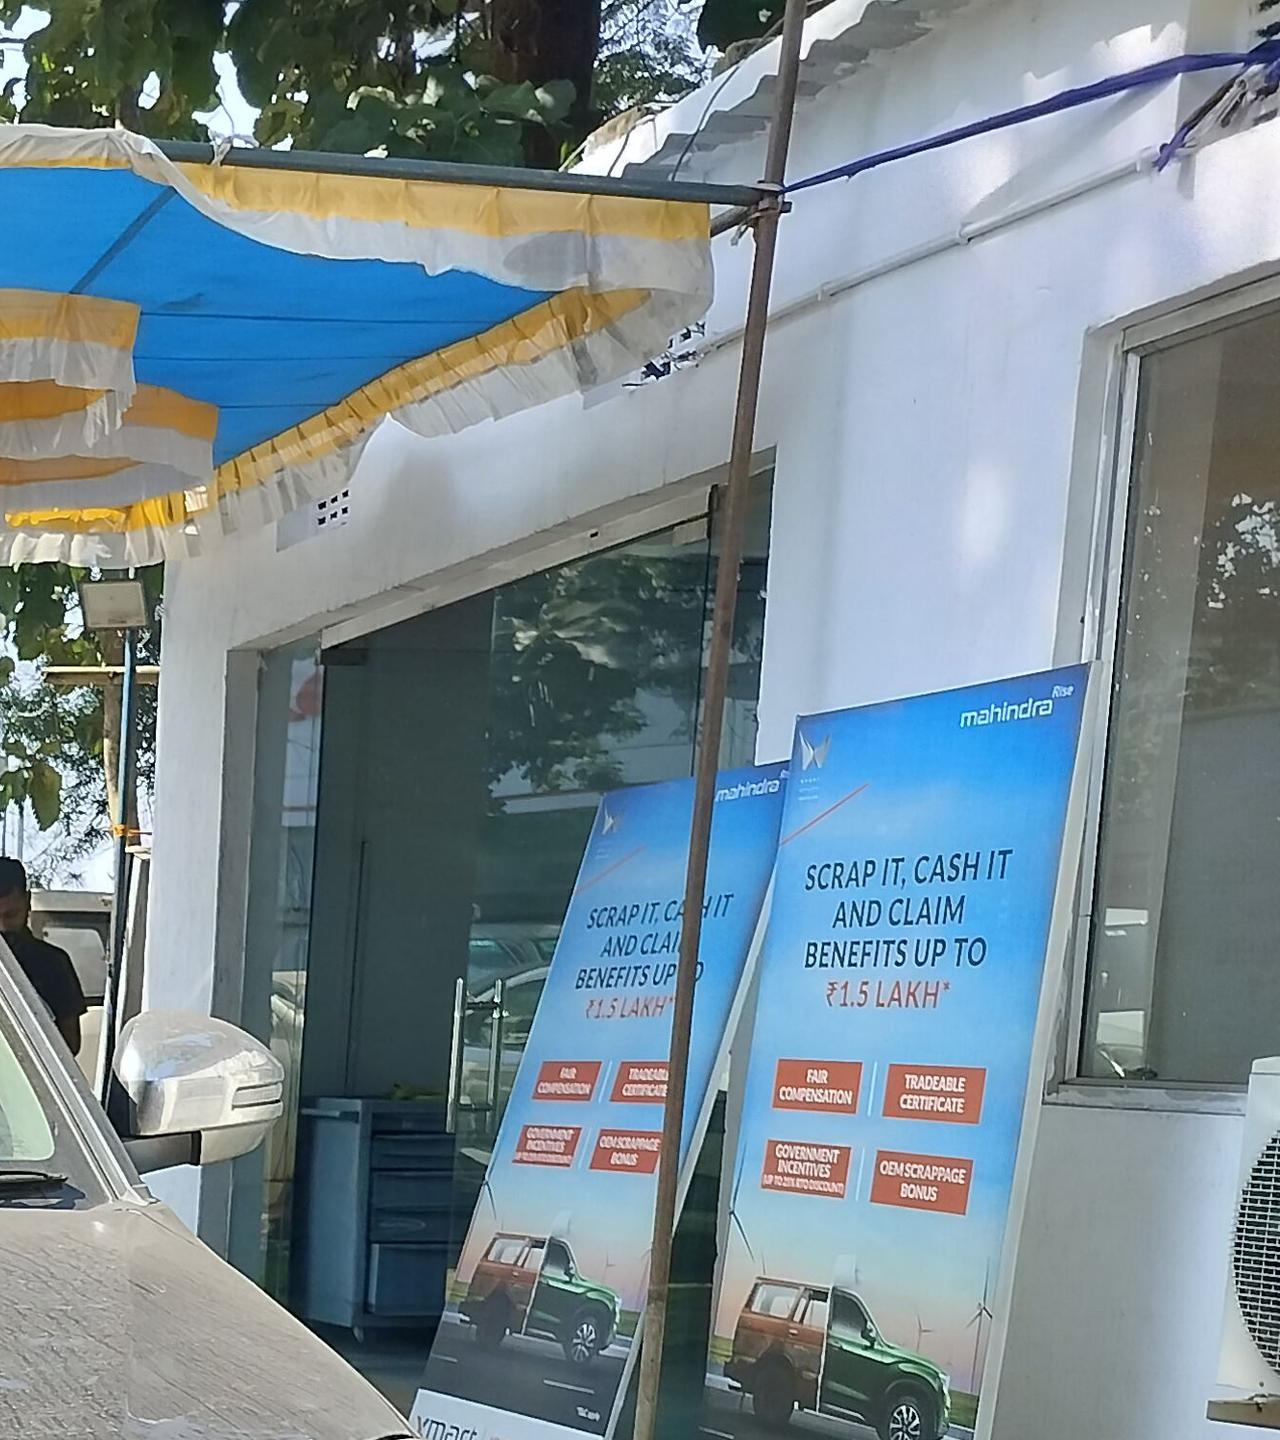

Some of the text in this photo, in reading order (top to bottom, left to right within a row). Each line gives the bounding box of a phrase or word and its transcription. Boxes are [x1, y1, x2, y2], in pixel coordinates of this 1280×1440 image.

[960, 698, 1053, 728] mahindra
[715, 779, 780, 801] mahindra
[805, 849, 1013, 890] SCRAP IT, CASH IT
[587, 904, 640, 929] SCRAP
[664, 896, 712, 922] CAH
[713, 894, 734, 918] IT
[832, 895, 965, 928] AND CLAIM
[600, 930, 682, 958] AND CLAI
[804, 937, 987, 968] BENEFITS UP TO
[575, 965, 652, 989] BENEFITS
[652, 963, 677, 986] UP
[806, 1068, 828, 1084] FAIR
[904, 1074, 966, 1093] TRADEABLE
[779, 1086, 853, 1105] COMPENSATION
[900, 1094, 965, 1113] CERTIFICATE
[775, 1143, 840, 1164] GOVERNMENT
[778, 1159, 832, 1179] INCENTIVES
[879, 1160, 967, 1184] OEM SCRAPPAGE
[900, 1183, 938, 1201] BONUS
